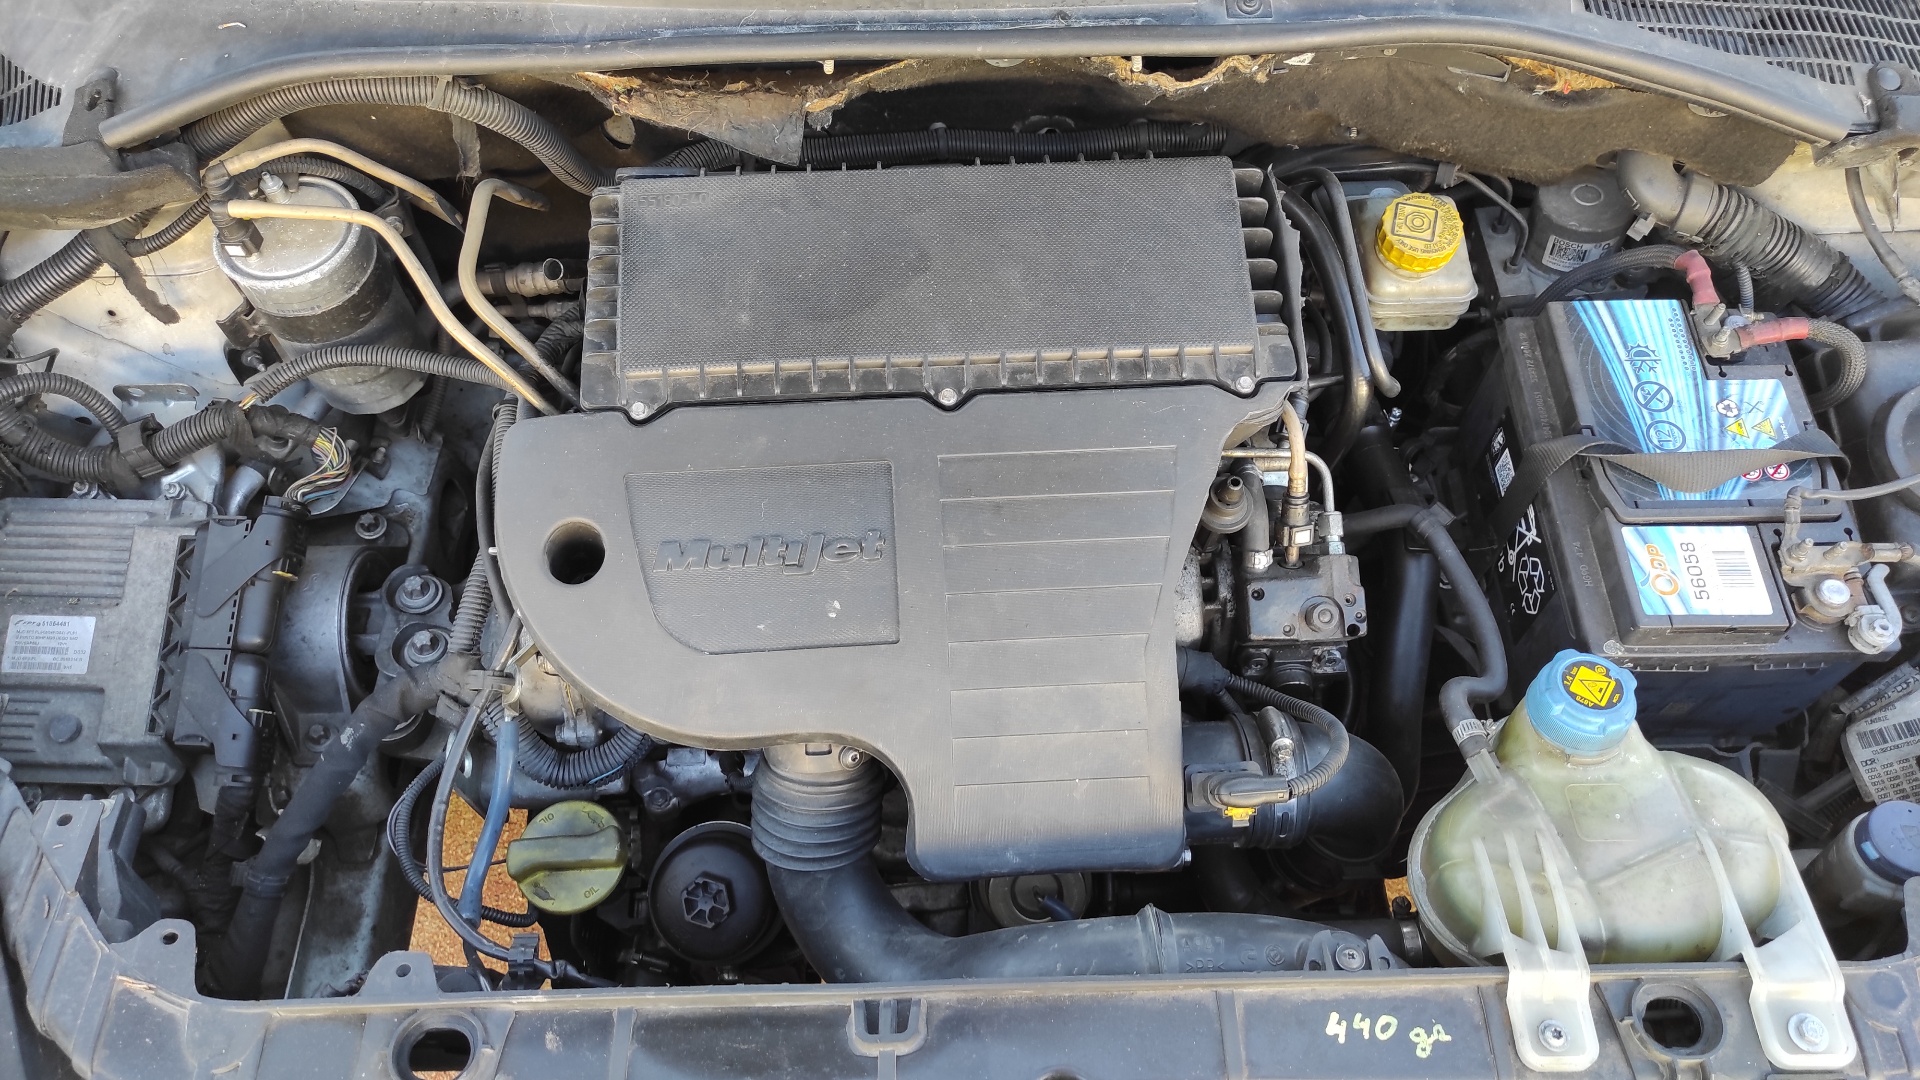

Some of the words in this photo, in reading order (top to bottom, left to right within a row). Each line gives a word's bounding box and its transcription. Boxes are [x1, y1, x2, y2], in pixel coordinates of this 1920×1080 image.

[1680, 542, 1710, 600] 56058
[538, 812, 555, 824] OIL
[583, 886, 600, 899] OIL
[1325, 1011, 1398, 1044] 440
